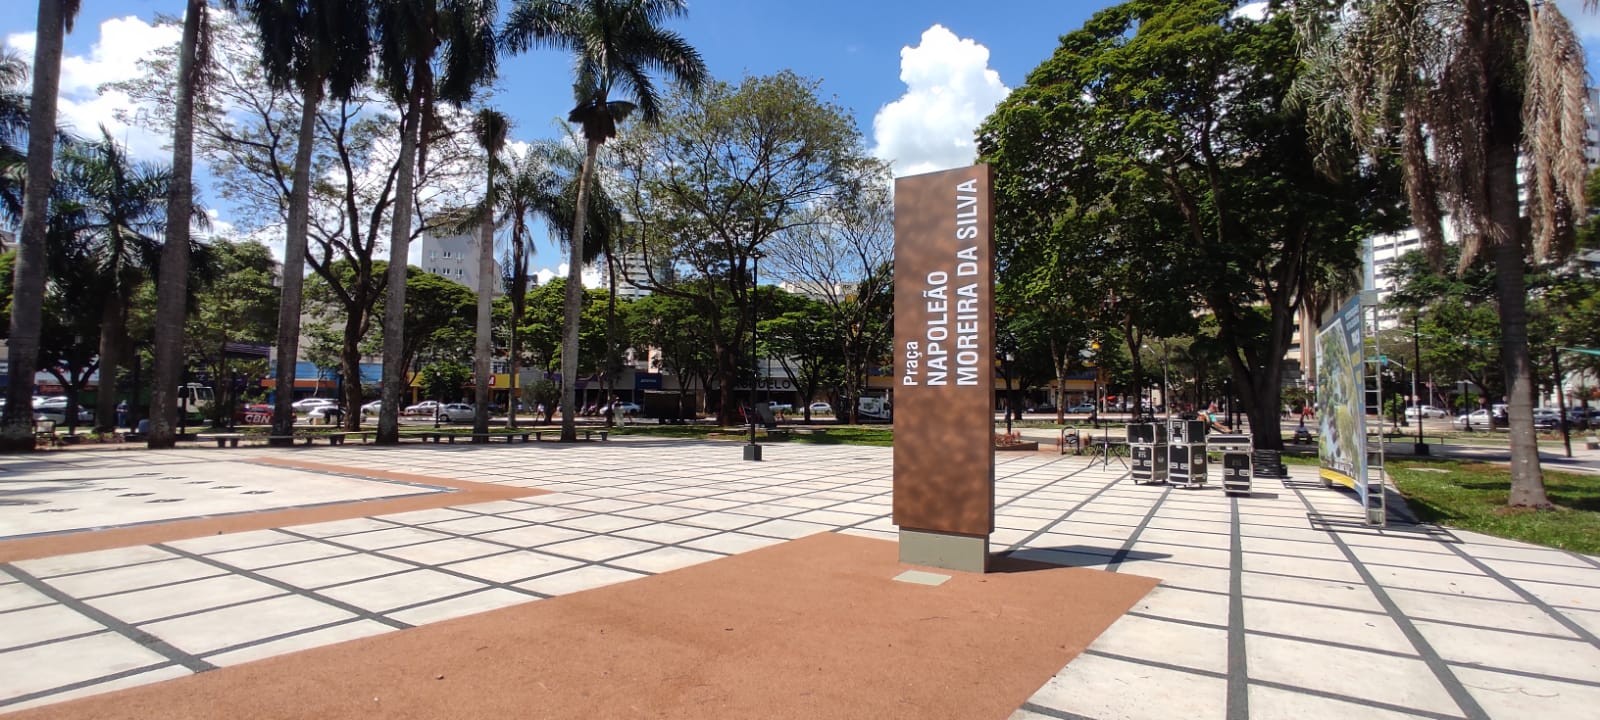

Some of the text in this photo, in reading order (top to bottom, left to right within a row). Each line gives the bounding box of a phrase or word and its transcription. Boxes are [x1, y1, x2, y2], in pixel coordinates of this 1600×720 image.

[923, 271, 948, 386] NAPOLEÃO
[957, 178, 979, 386] MOREIRA DA SILVA
[903, 341, 922, 386] Praça
